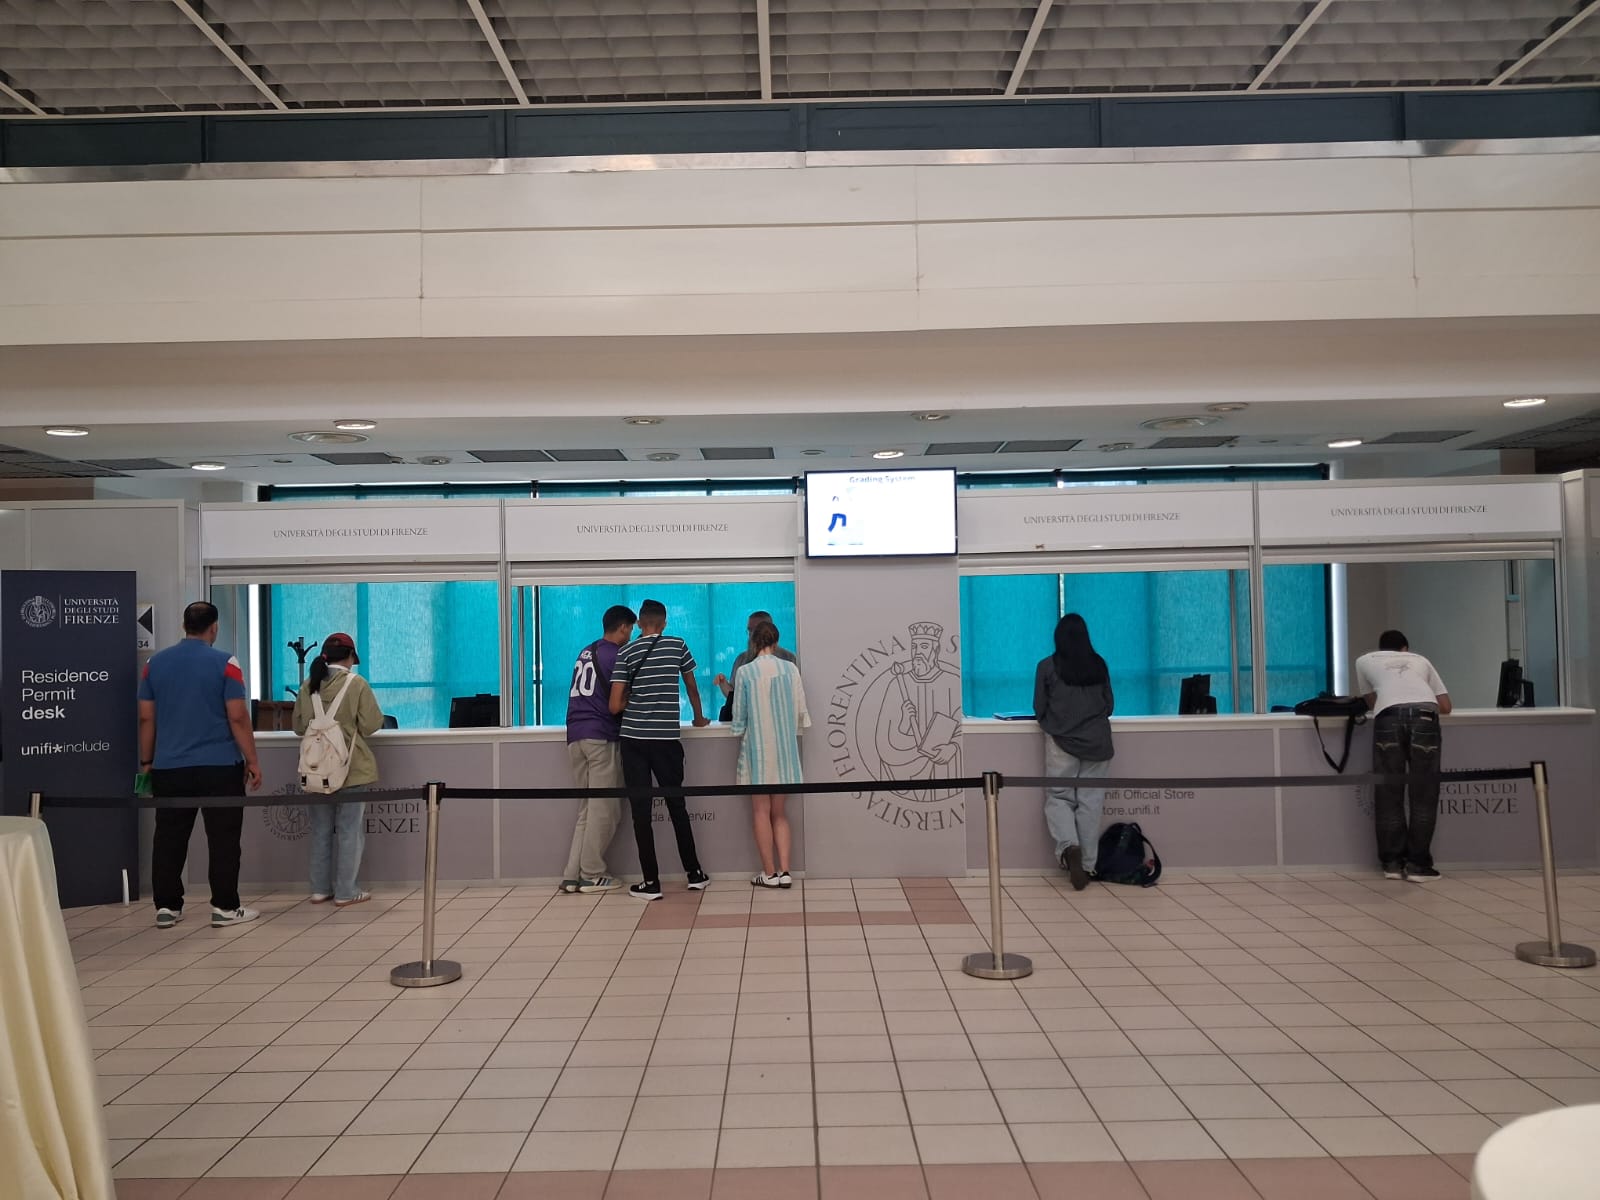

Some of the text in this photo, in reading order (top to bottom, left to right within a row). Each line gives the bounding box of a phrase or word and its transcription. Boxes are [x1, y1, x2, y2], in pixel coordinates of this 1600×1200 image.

[849, 476, 883, 484] Grading
[1383, 506, 1410, 516] DEGLI
[1411, 506, 1438, 515] STUDI
[1439, 505, 1449, 514] DI
[1450, 505, 1488, 514] FIRENZE
[1077, 514, 1103, 523] DEGLI
[1104, 513, 1131, 522] STUDI
[1132, 513, 1142, 522] DI
[1143, 512, 1181, 521] FIRENZE
[325, 528, 351, 537] DEGLI
[352, 528, 379, 537] STUDI
[380, 528, 390, 536] DI
[391, 527, 428, 536] FIRENZE
[628, 524, 654, 533] DEGLI
[655, 524, 681, 533] STUDI
[682, 524, 692, 532] DI
[693, 523, 728, 532] FIRENZE
[64, 615, 119, 625] FIRENZE
[21, 669, 109, 684] Residence
[22, 687, 76, 702] Permit
[21, 705, 66, 720] desk
[827, 635, 907, 778] FLORENTINA
[1104, 788, 1195, 800] nifi Official Store
[1440, 783, 1517, 794] EGLI STUDI
[377, 802, 420, 814] STUDI
[851, 790, 965, 830] VERSITA
[1102, 804, 1160, 816] tore.unifi.it
[1440, 798, 1519, 814] IRENZE
[689, 811, 715, 821] ervizi
[365, 817, 420, 834] ENZE
